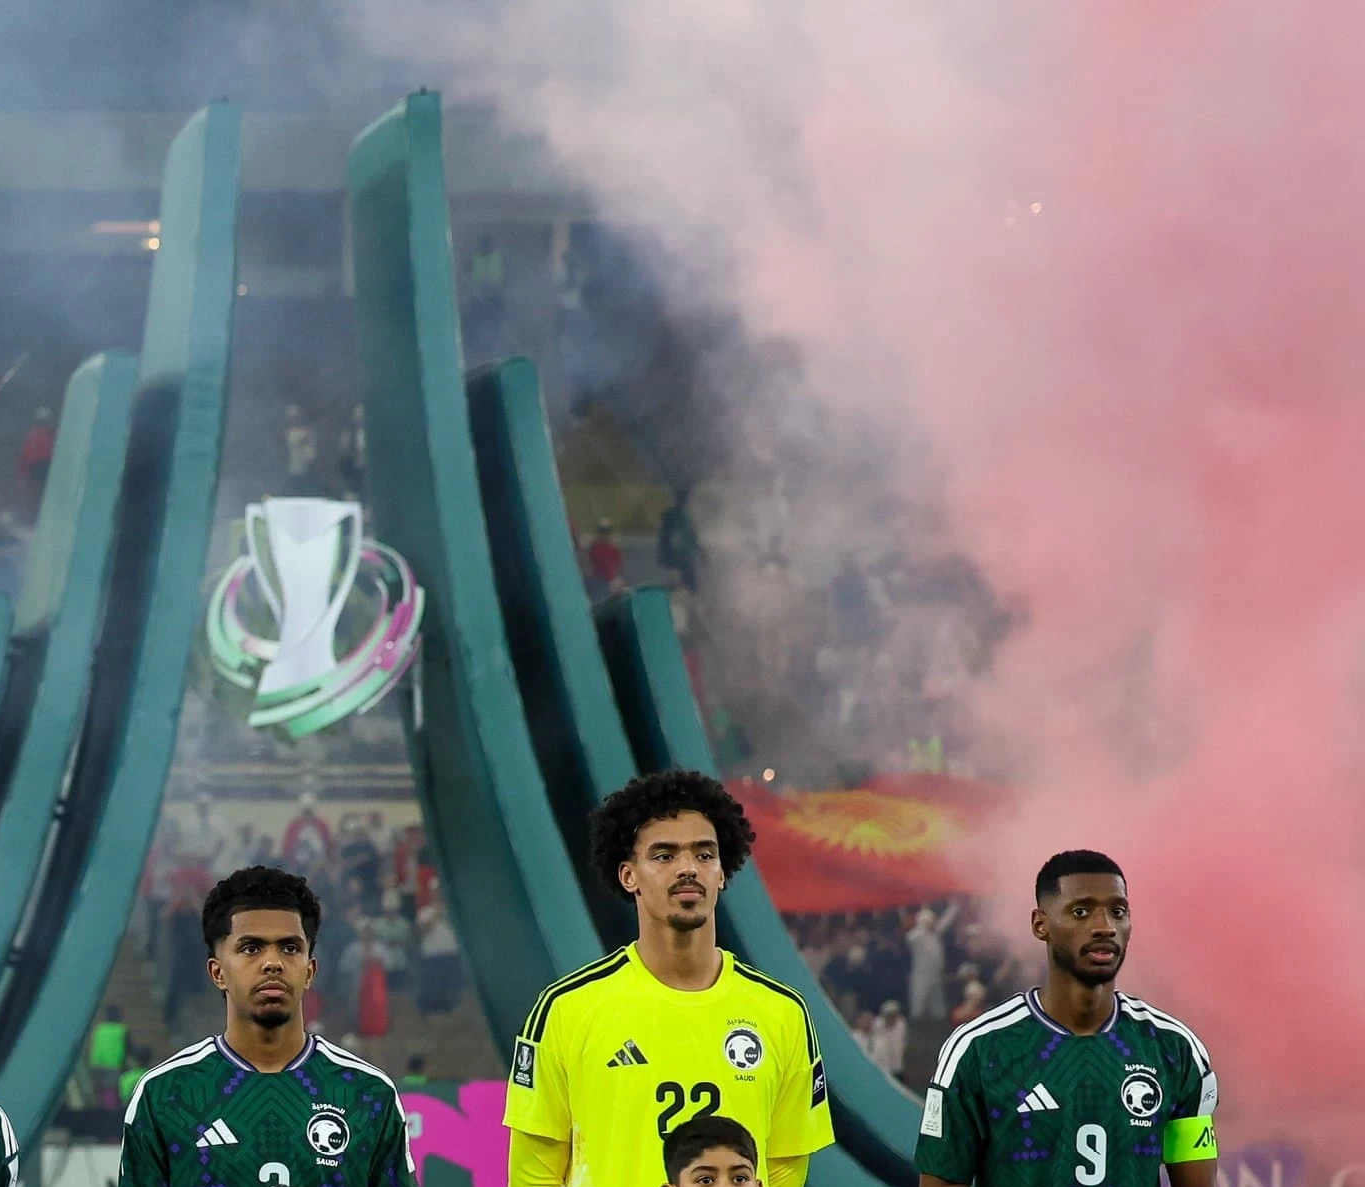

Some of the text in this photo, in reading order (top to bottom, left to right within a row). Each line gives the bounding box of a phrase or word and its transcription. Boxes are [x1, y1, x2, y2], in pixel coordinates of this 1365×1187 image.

[656, 1081, 722, 1141] 22
[1129, 1118, 1152, 1127] SAUDI
[315, 1157, 338, 1167] SAUDI
[1075, 1123, 1107, 1186] 9
